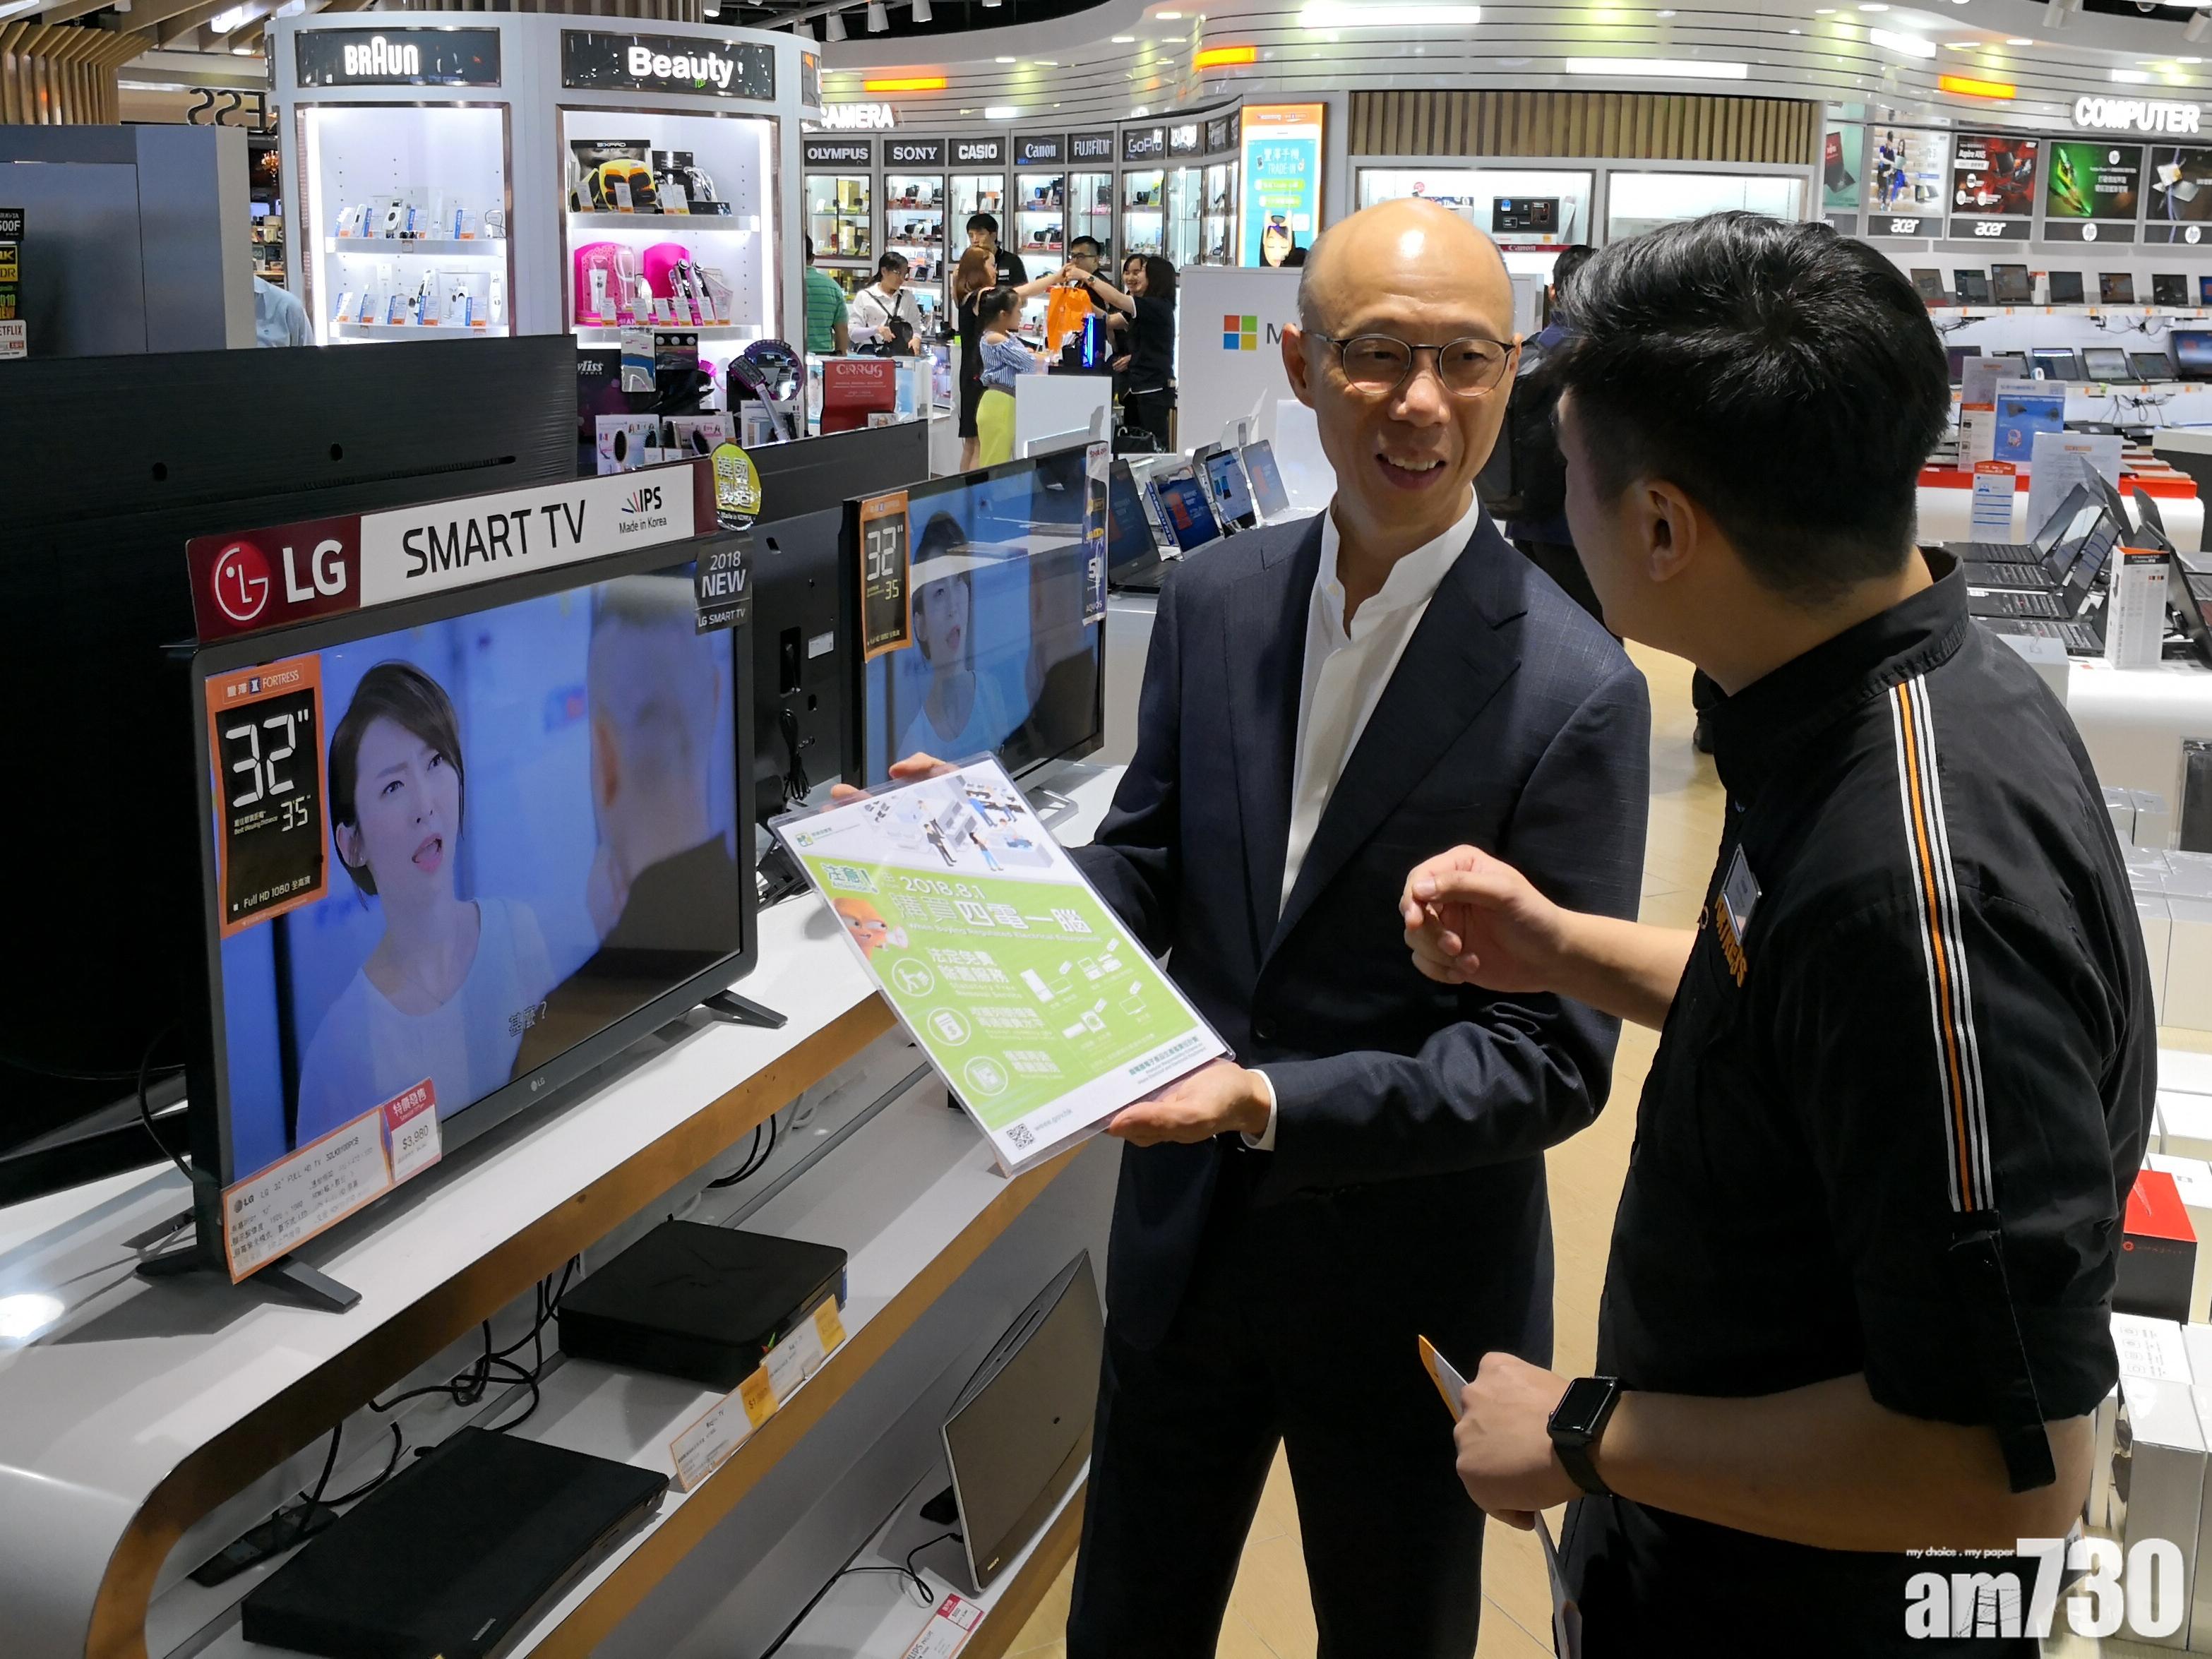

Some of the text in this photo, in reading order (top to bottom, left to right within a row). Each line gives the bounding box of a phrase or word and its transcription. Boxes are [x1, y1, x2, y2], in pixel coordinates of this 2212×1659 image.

[344, 36, 419, 77] BRAUN
[628, 46, 734, 88] Beauty
[2074, 97, 2201, 134] COMPUTER
[807, 147, 868, 161] OLYMPUS
[892, 146, 938, 160] SONY
[958, 144, 998, 160] CASIO
[1024, 143, 1057, 158] Canon
[1073, 140, 1113, 157] FUJIFILM
[1128, 136, 1164, 153] GoPro
[1890, 217, 1920, 234] acer
[1974, 221, 2007, 238] acer
[639, 486, 663, 513] IPS
[618, 516, 668, 535] Made in Korea
[283, 500, 587, 605] LG SMART TV
[710, 551, 741, 571] 2018
[701, 569, 746, 599] NEW
[698, 608, 746, 628] LG SMART TV
[262, 669, 299, 689] FORTRESS
[244, 893, 258, 909] Full
[258, 891, 270, 902] HD
[271, 882, 290, 898] 1080
[900, 876, 986, 900] 2018.8.1
[890, 893, 1093, 934] 購買四電一腦
[537, 1077, 546, 1087] LG
[402, 1125, 429, 1151] $3,980
[243, 1194, 254, 1207] LG
